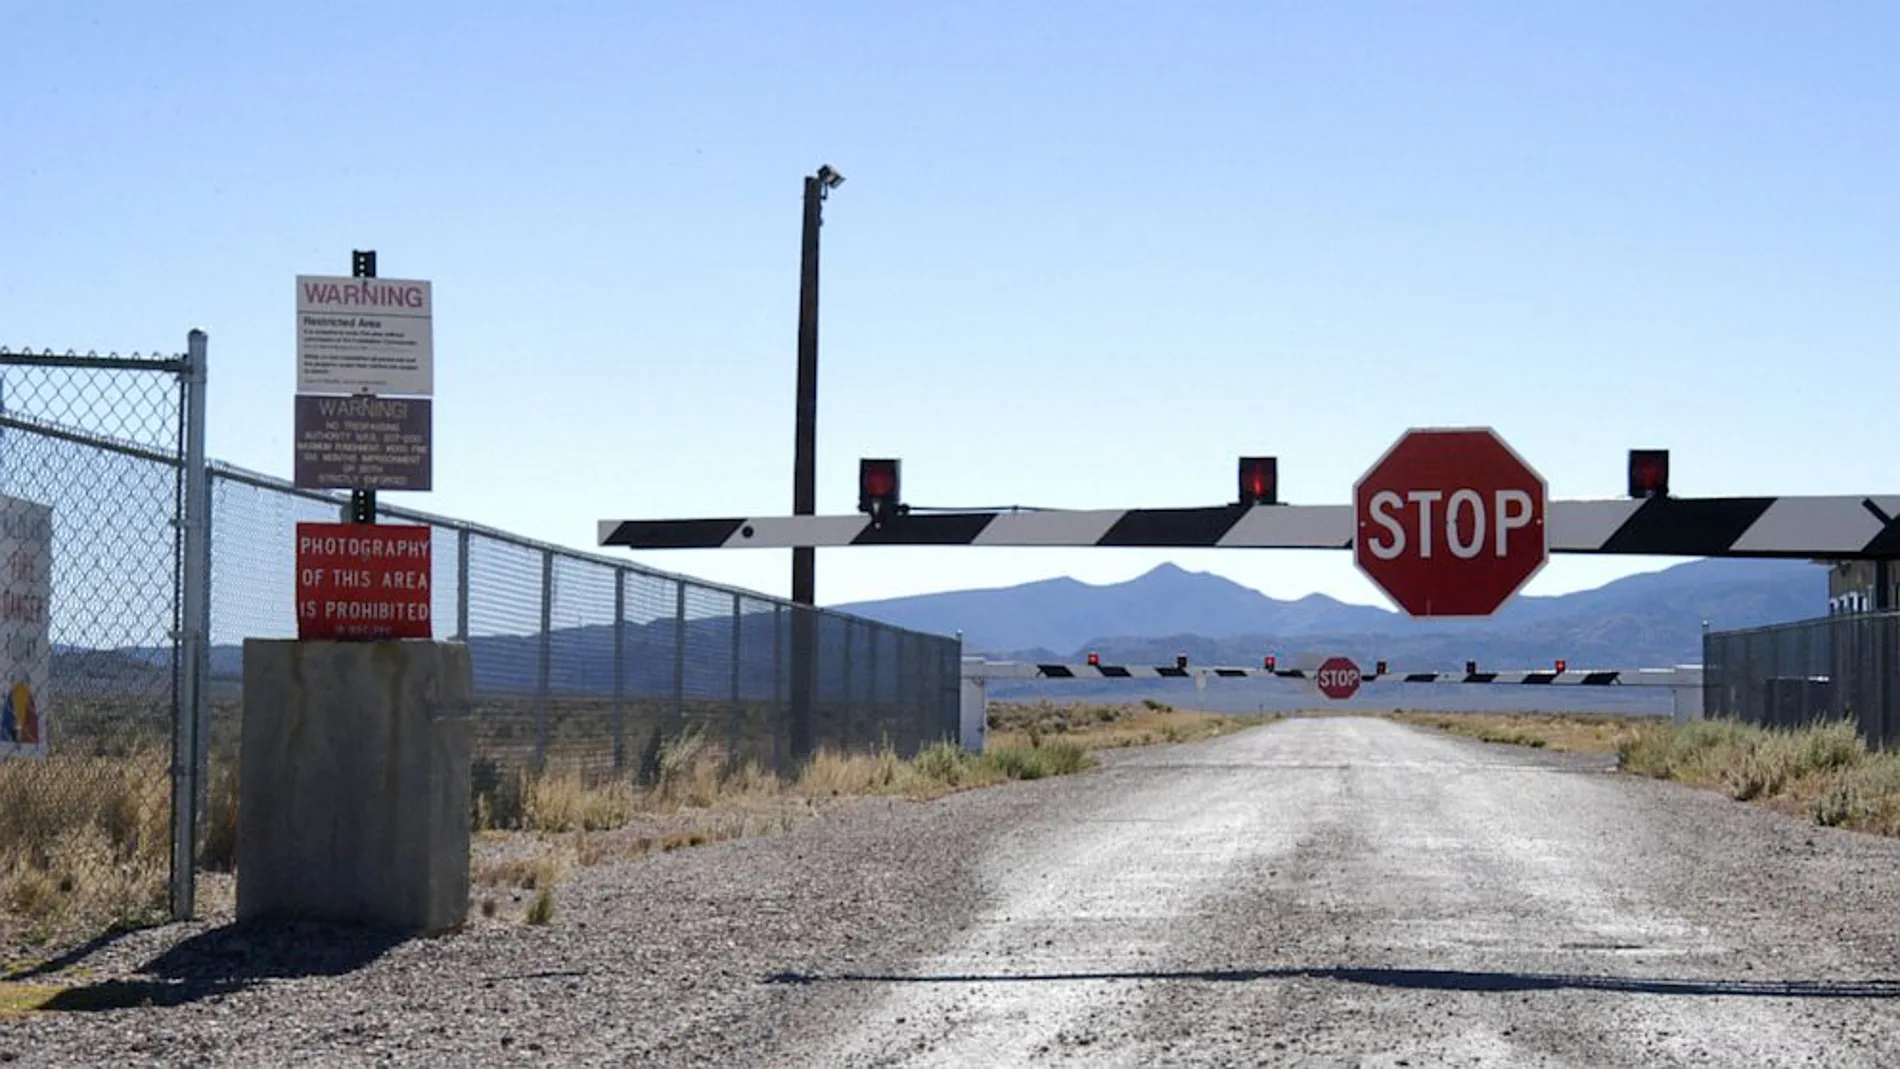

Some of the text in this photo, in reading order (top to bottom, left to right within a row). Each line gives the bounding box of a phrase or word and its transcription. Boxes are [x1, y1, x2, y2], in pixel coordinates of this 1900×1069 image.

[304, 283, 423, 308] WARNING
[303, 315, 382, 329] Restricted Area
[1368, 489, 1533, 560] STOP
[300, 537, 429, 558] PHOTOGRAPHY
[302, 568, 428, 590] OF THIS AREA
[300, 600, 428, 620] IS PROHIBITED
[1320, 669, 1359, 687] STOP
